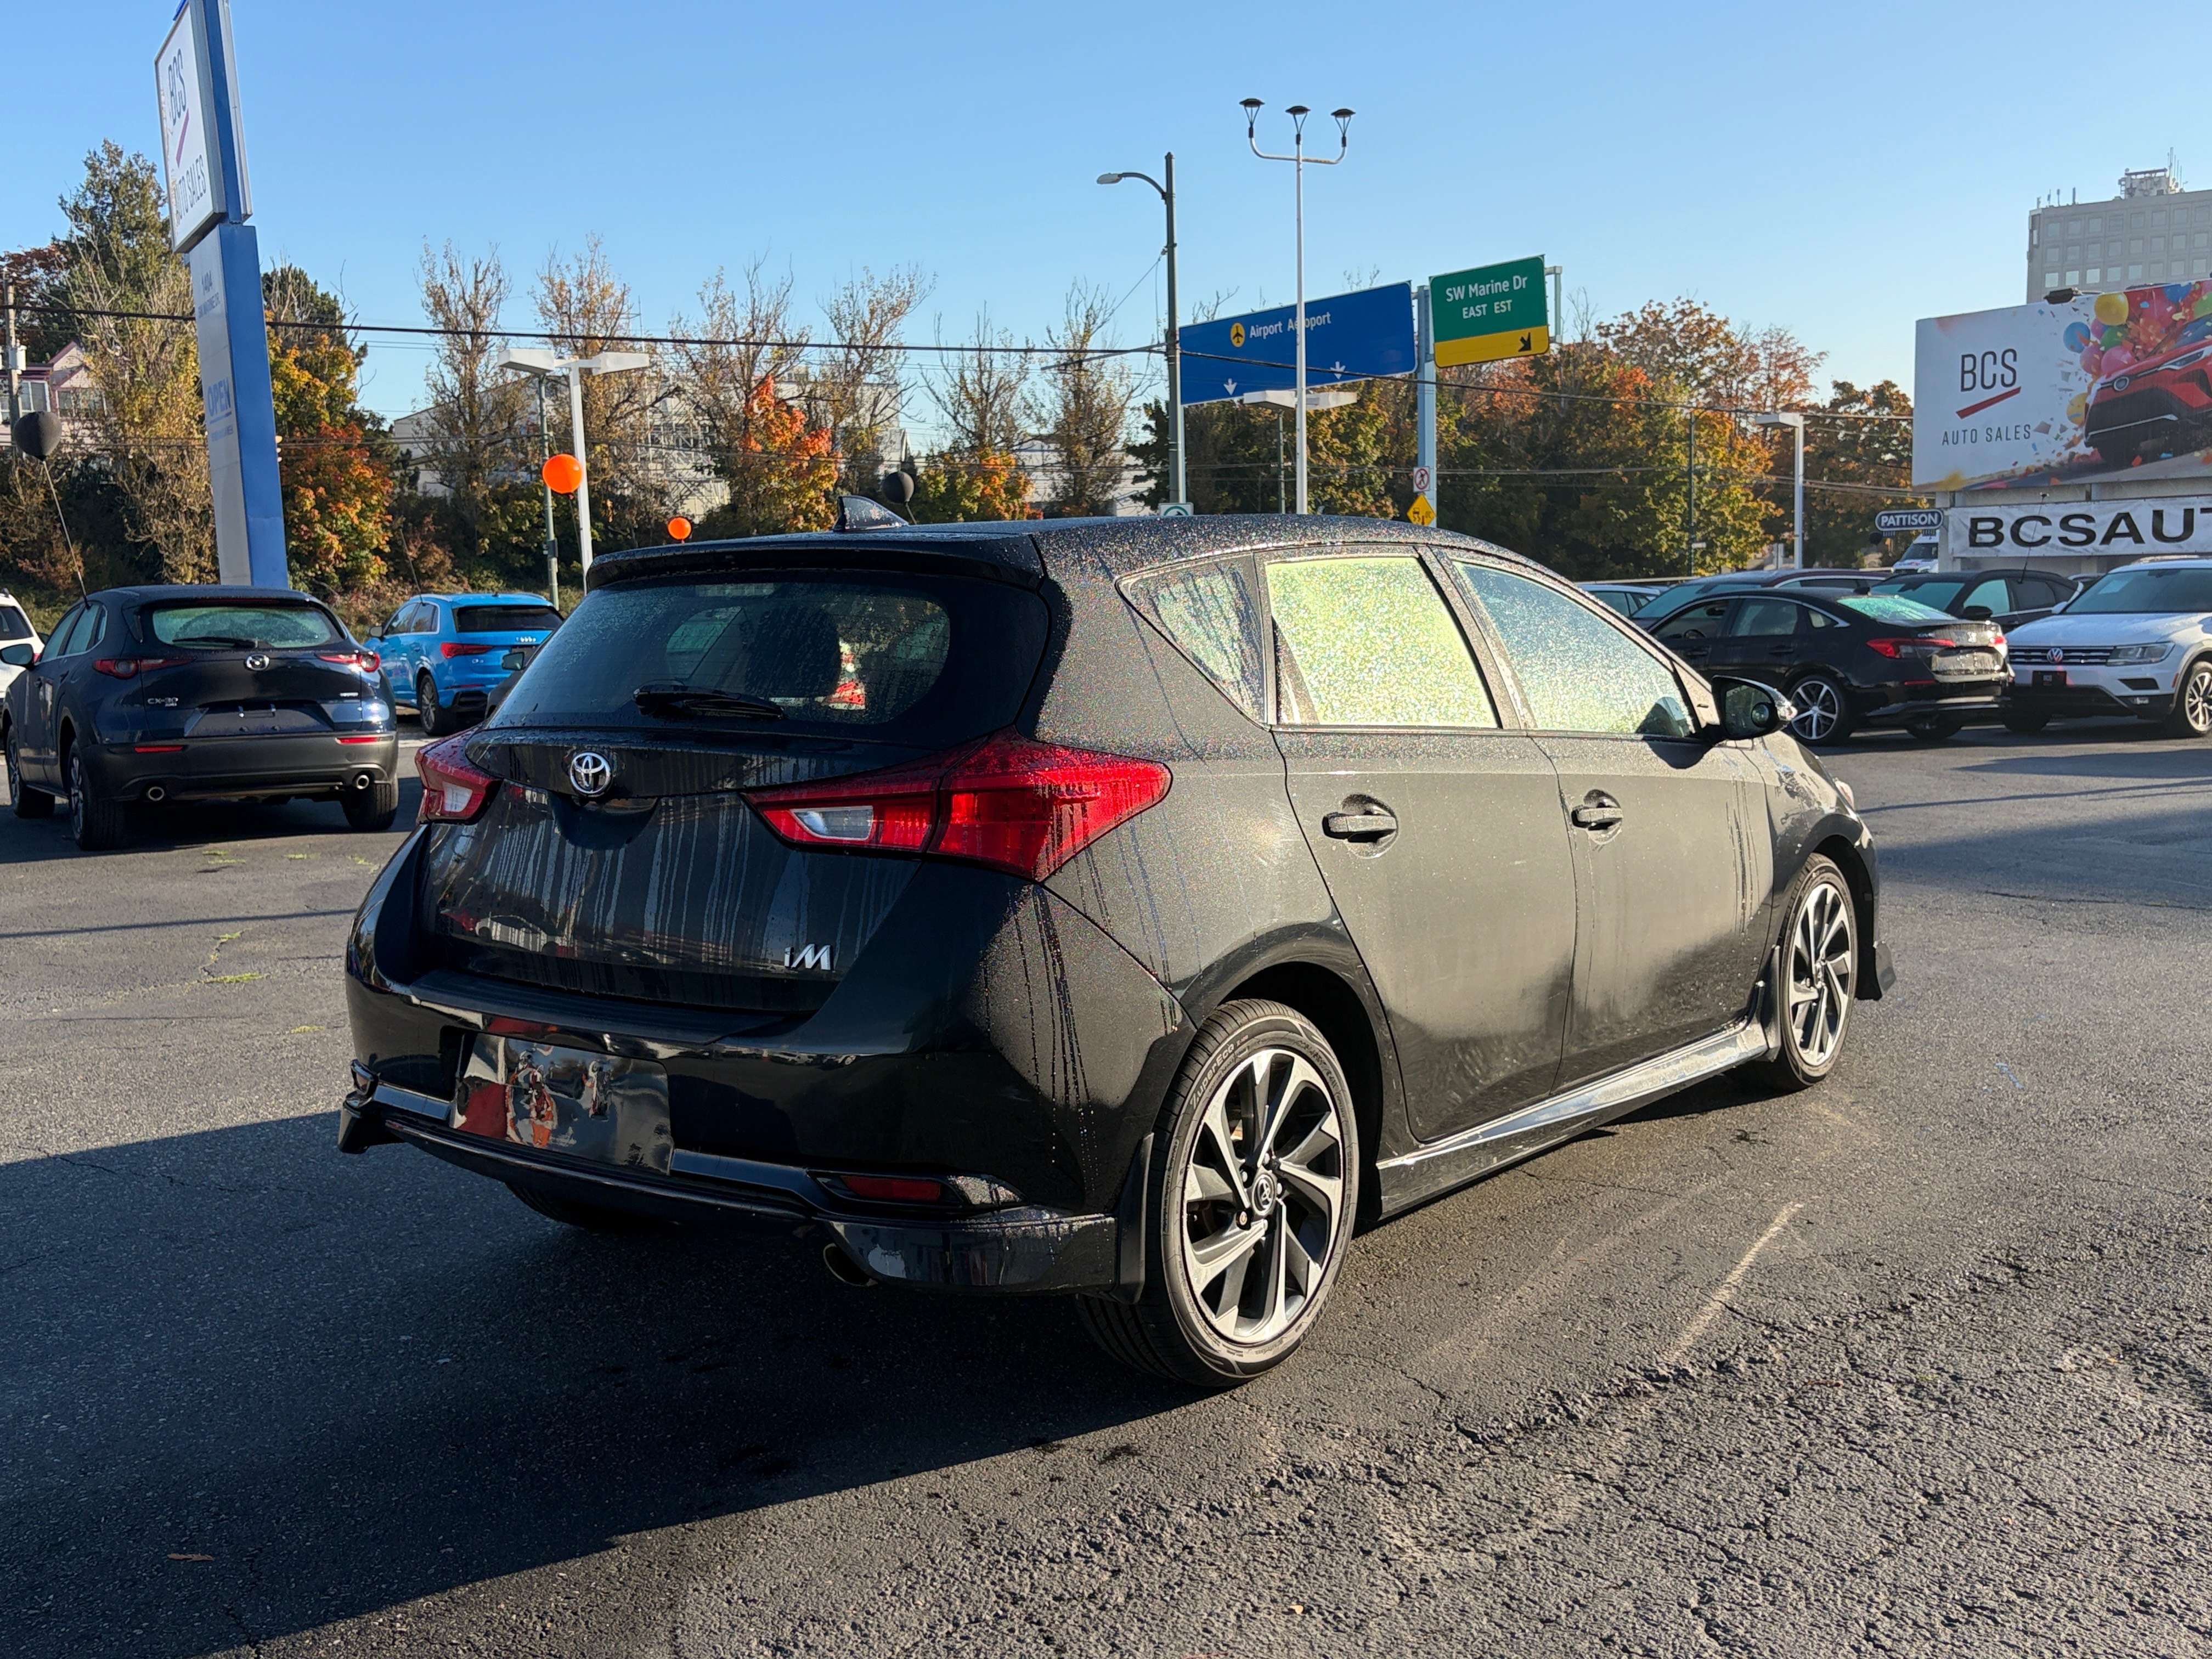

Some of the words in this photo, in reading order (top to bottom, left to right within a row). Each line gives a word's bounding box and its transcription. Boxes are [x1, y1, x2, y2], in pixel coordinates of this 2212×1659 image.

[168, 48, 187, 126] BCS
[187, 154, 206, 208] SALES
[1446, 285, 1465, 302] SW
[1469, 280, 1509, 298] Marine
[1513, 275, 1527, 290] Dr
[1462, 304, 1487, 319] EAST
[1494, 300, 1513, 314] EST
[1249, 321, 1283, 339] Airport
[1961, 348, 2017, 392] BCS
[207, 377, 230, 416] OPEN
[1942, 428, 1978, 445] AUTO
[1985, 424, 2031, 442] SALES
[1881, 513, 1938, 527] PATTISON
